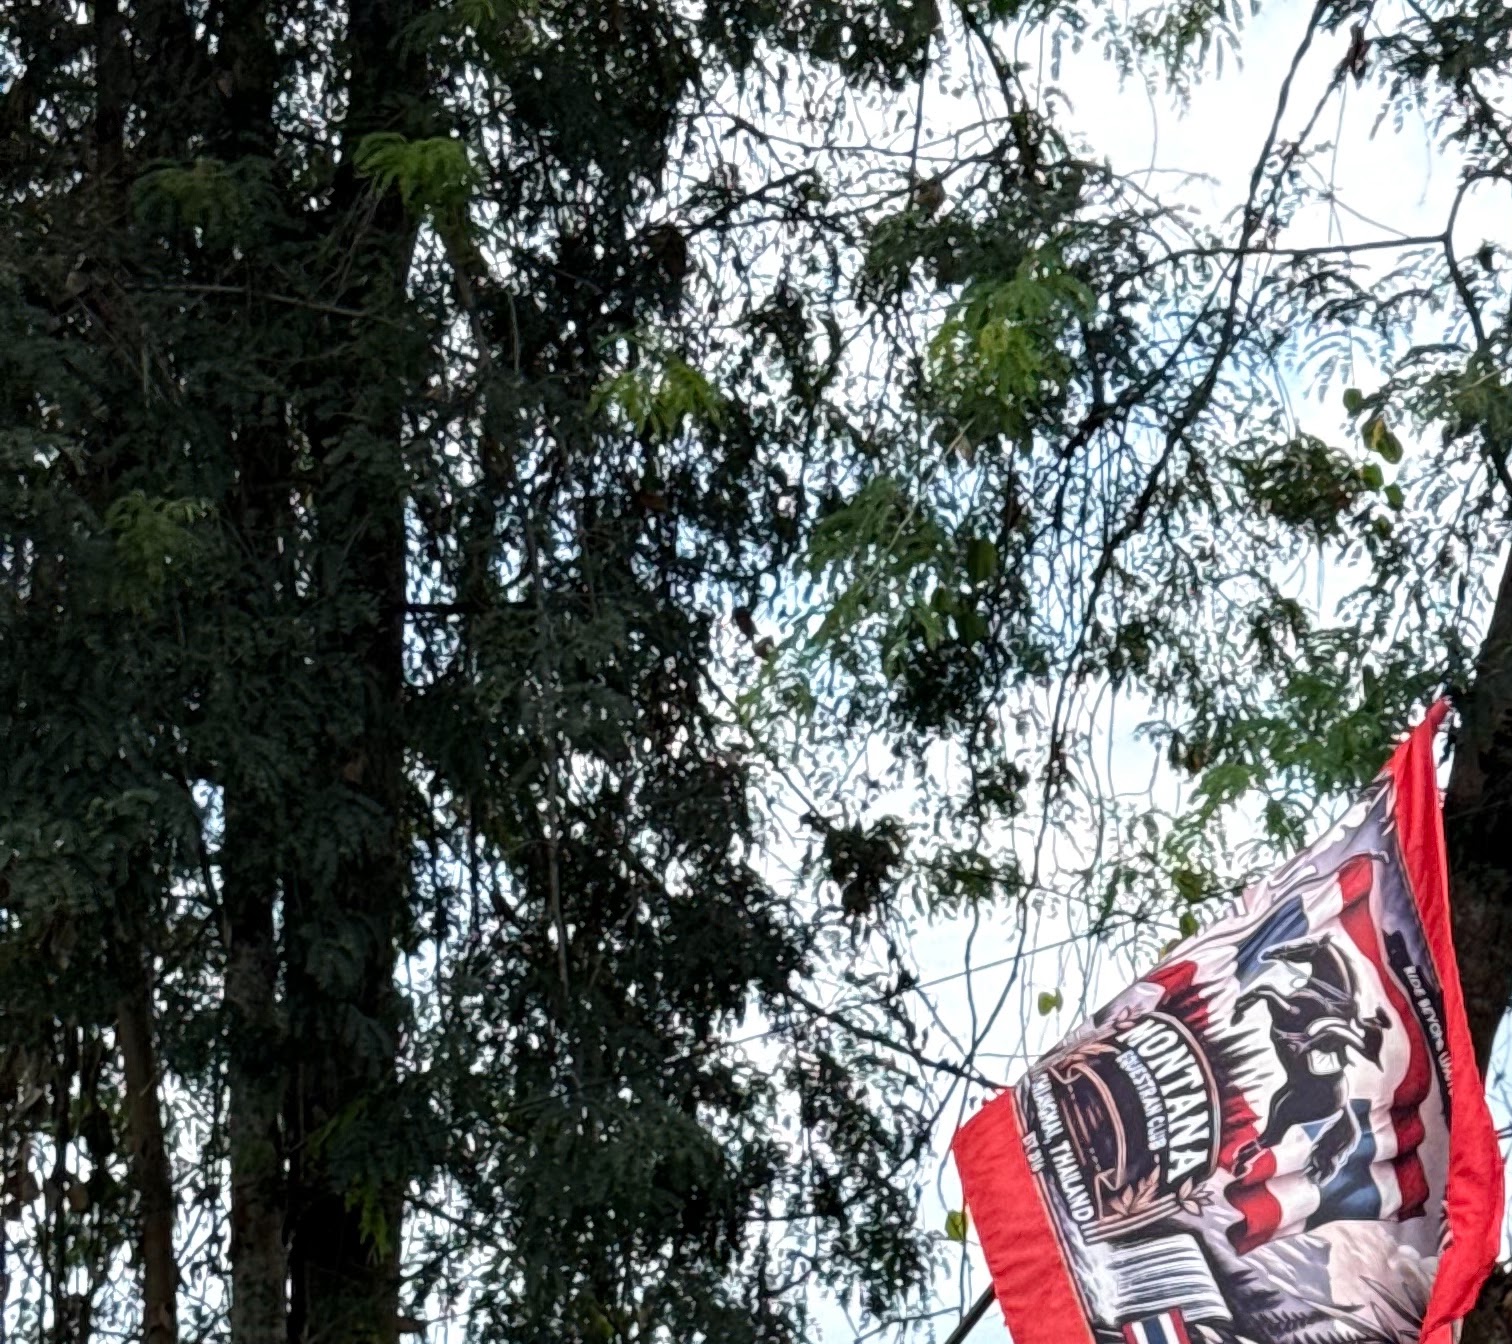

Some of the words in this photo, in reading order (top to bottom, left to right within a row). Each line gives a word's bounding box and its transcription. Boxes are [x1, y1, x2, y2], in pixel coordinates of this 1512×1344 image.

[1403, 965, 1427, 997] RIDE
[1115, 1019, 1210, 1184] MONTANA
[1147, 1115, 1168, 1151] CLUB
[1049, 1139, 1095, 1222] THAILAND
